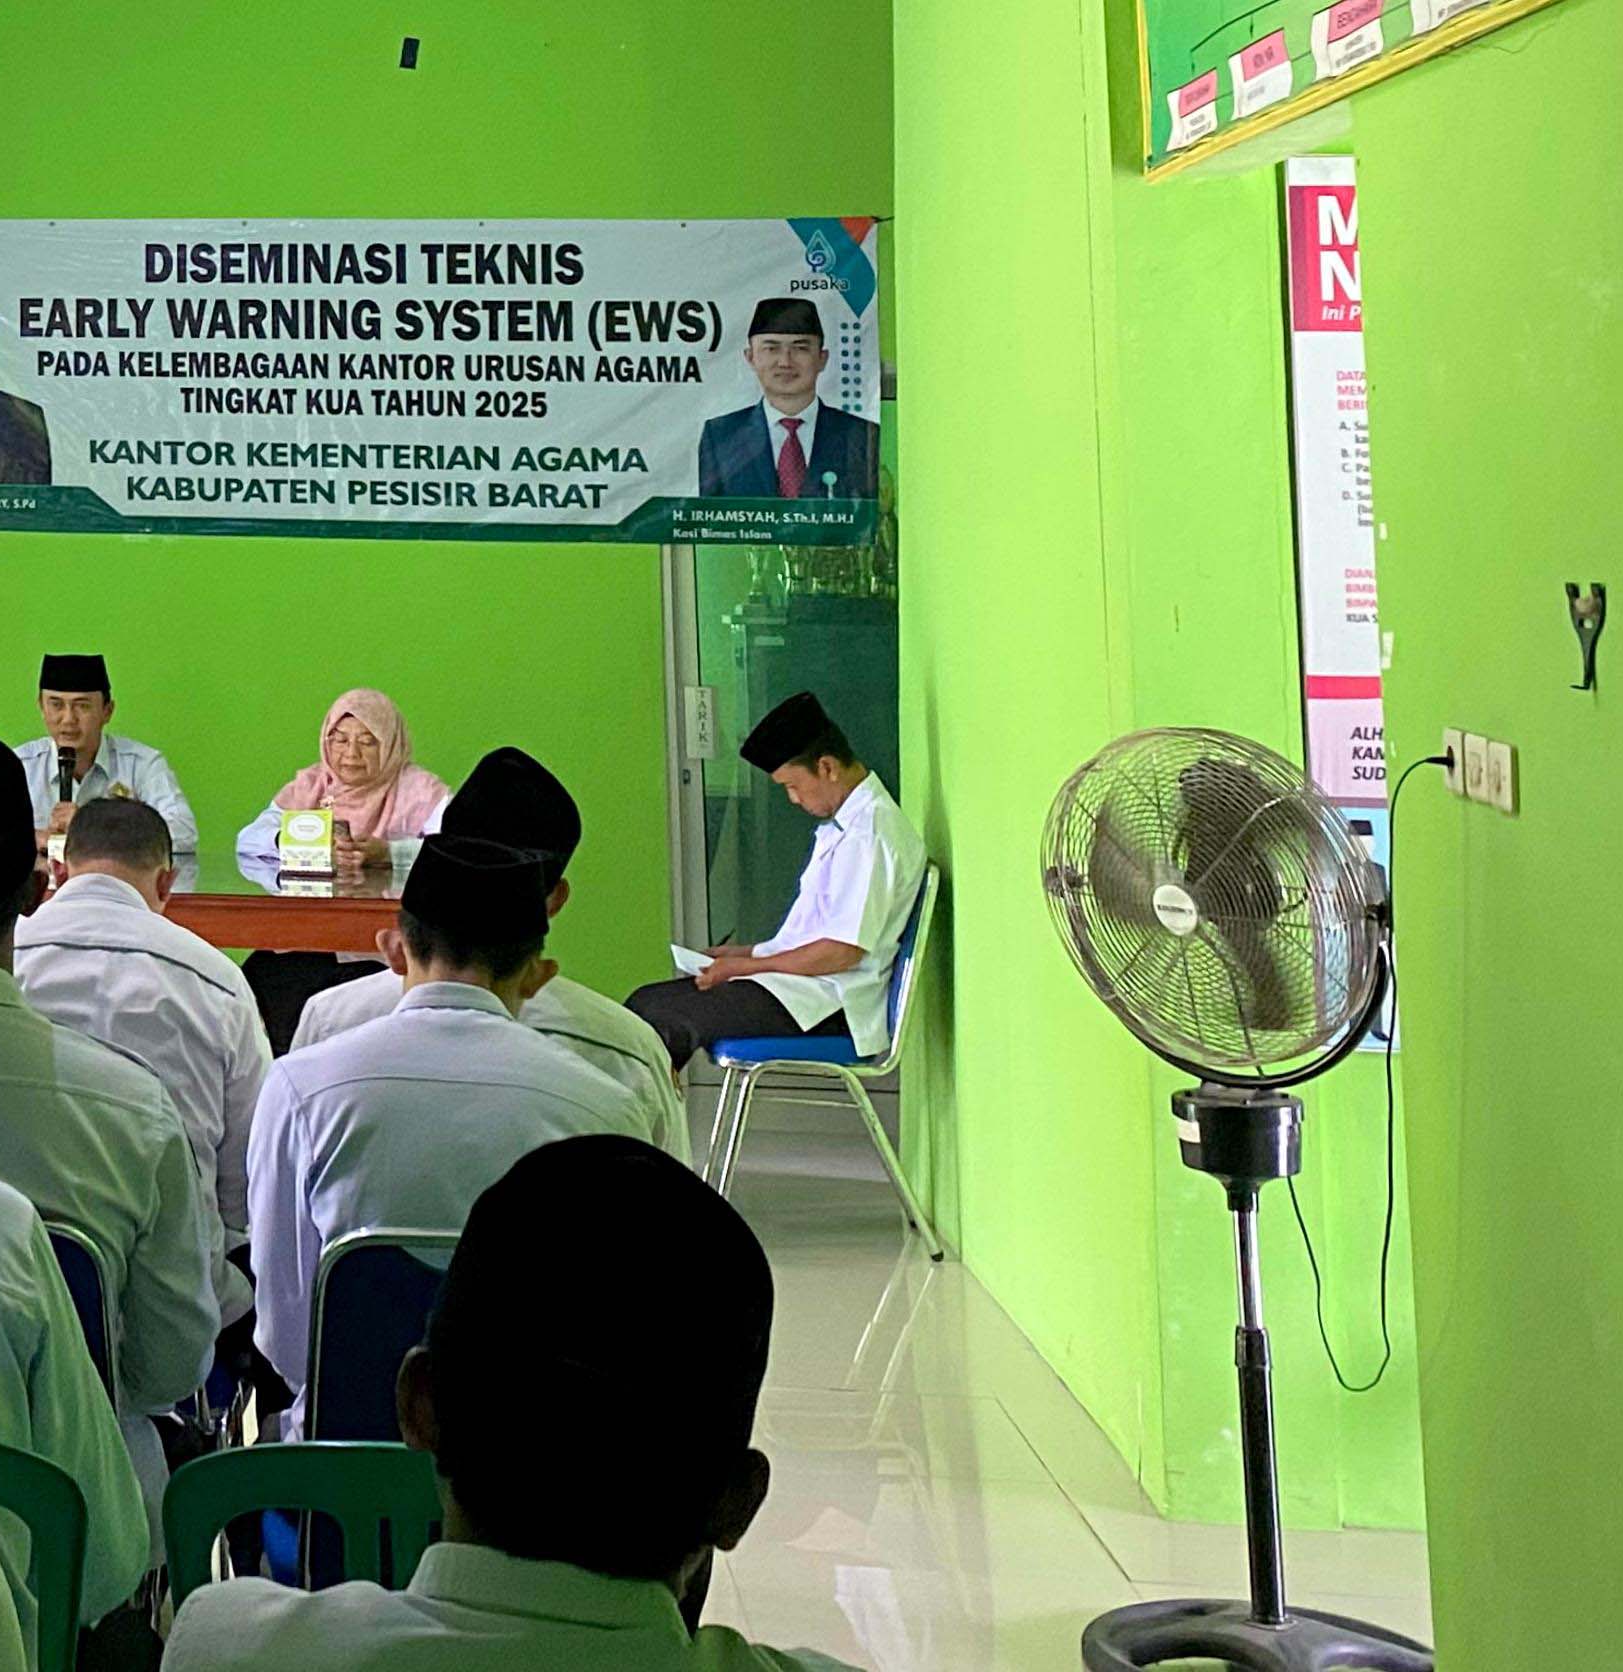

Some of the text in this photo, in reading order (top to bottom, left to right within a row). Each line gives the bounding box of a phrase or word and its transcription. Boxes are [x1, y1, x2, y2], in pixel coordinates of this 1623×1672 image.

[145, 243, 584, 286] DISEMINASI TEKNIS
[790, 273, 850, 293] pusaka
[19, 297, 723, 353] EARLY WARNING SYSTEM (EWS)
[1322, 305, 1345, 321] Ini
[37, 350, 703, 383] PADA KELEMBAGAAN KANTOR URUSAN AGAMA
[180, 387, 548, 419] TINGKAT KUA TAHUN 2025
[89, 439, 649, 473] KANTOR KEMENTERIAN AGAMA
[13, 498, 36, 509] S.Pd
[127, 476, 609, 510] KABUPATEN PESISIR BARAT
[672, 510, 687, 521] H.
[691, 510, 779, 524] IRHAMSYAH,
[822, 513, 854, 524] M.H.I
[673, 528, 772, 539] Kasi Bimas Islam
[697, 689, 708, 743] TARIK
[1350, 726, 1384, 740] ALH
[1352, 766, 1386, 780] SUD
